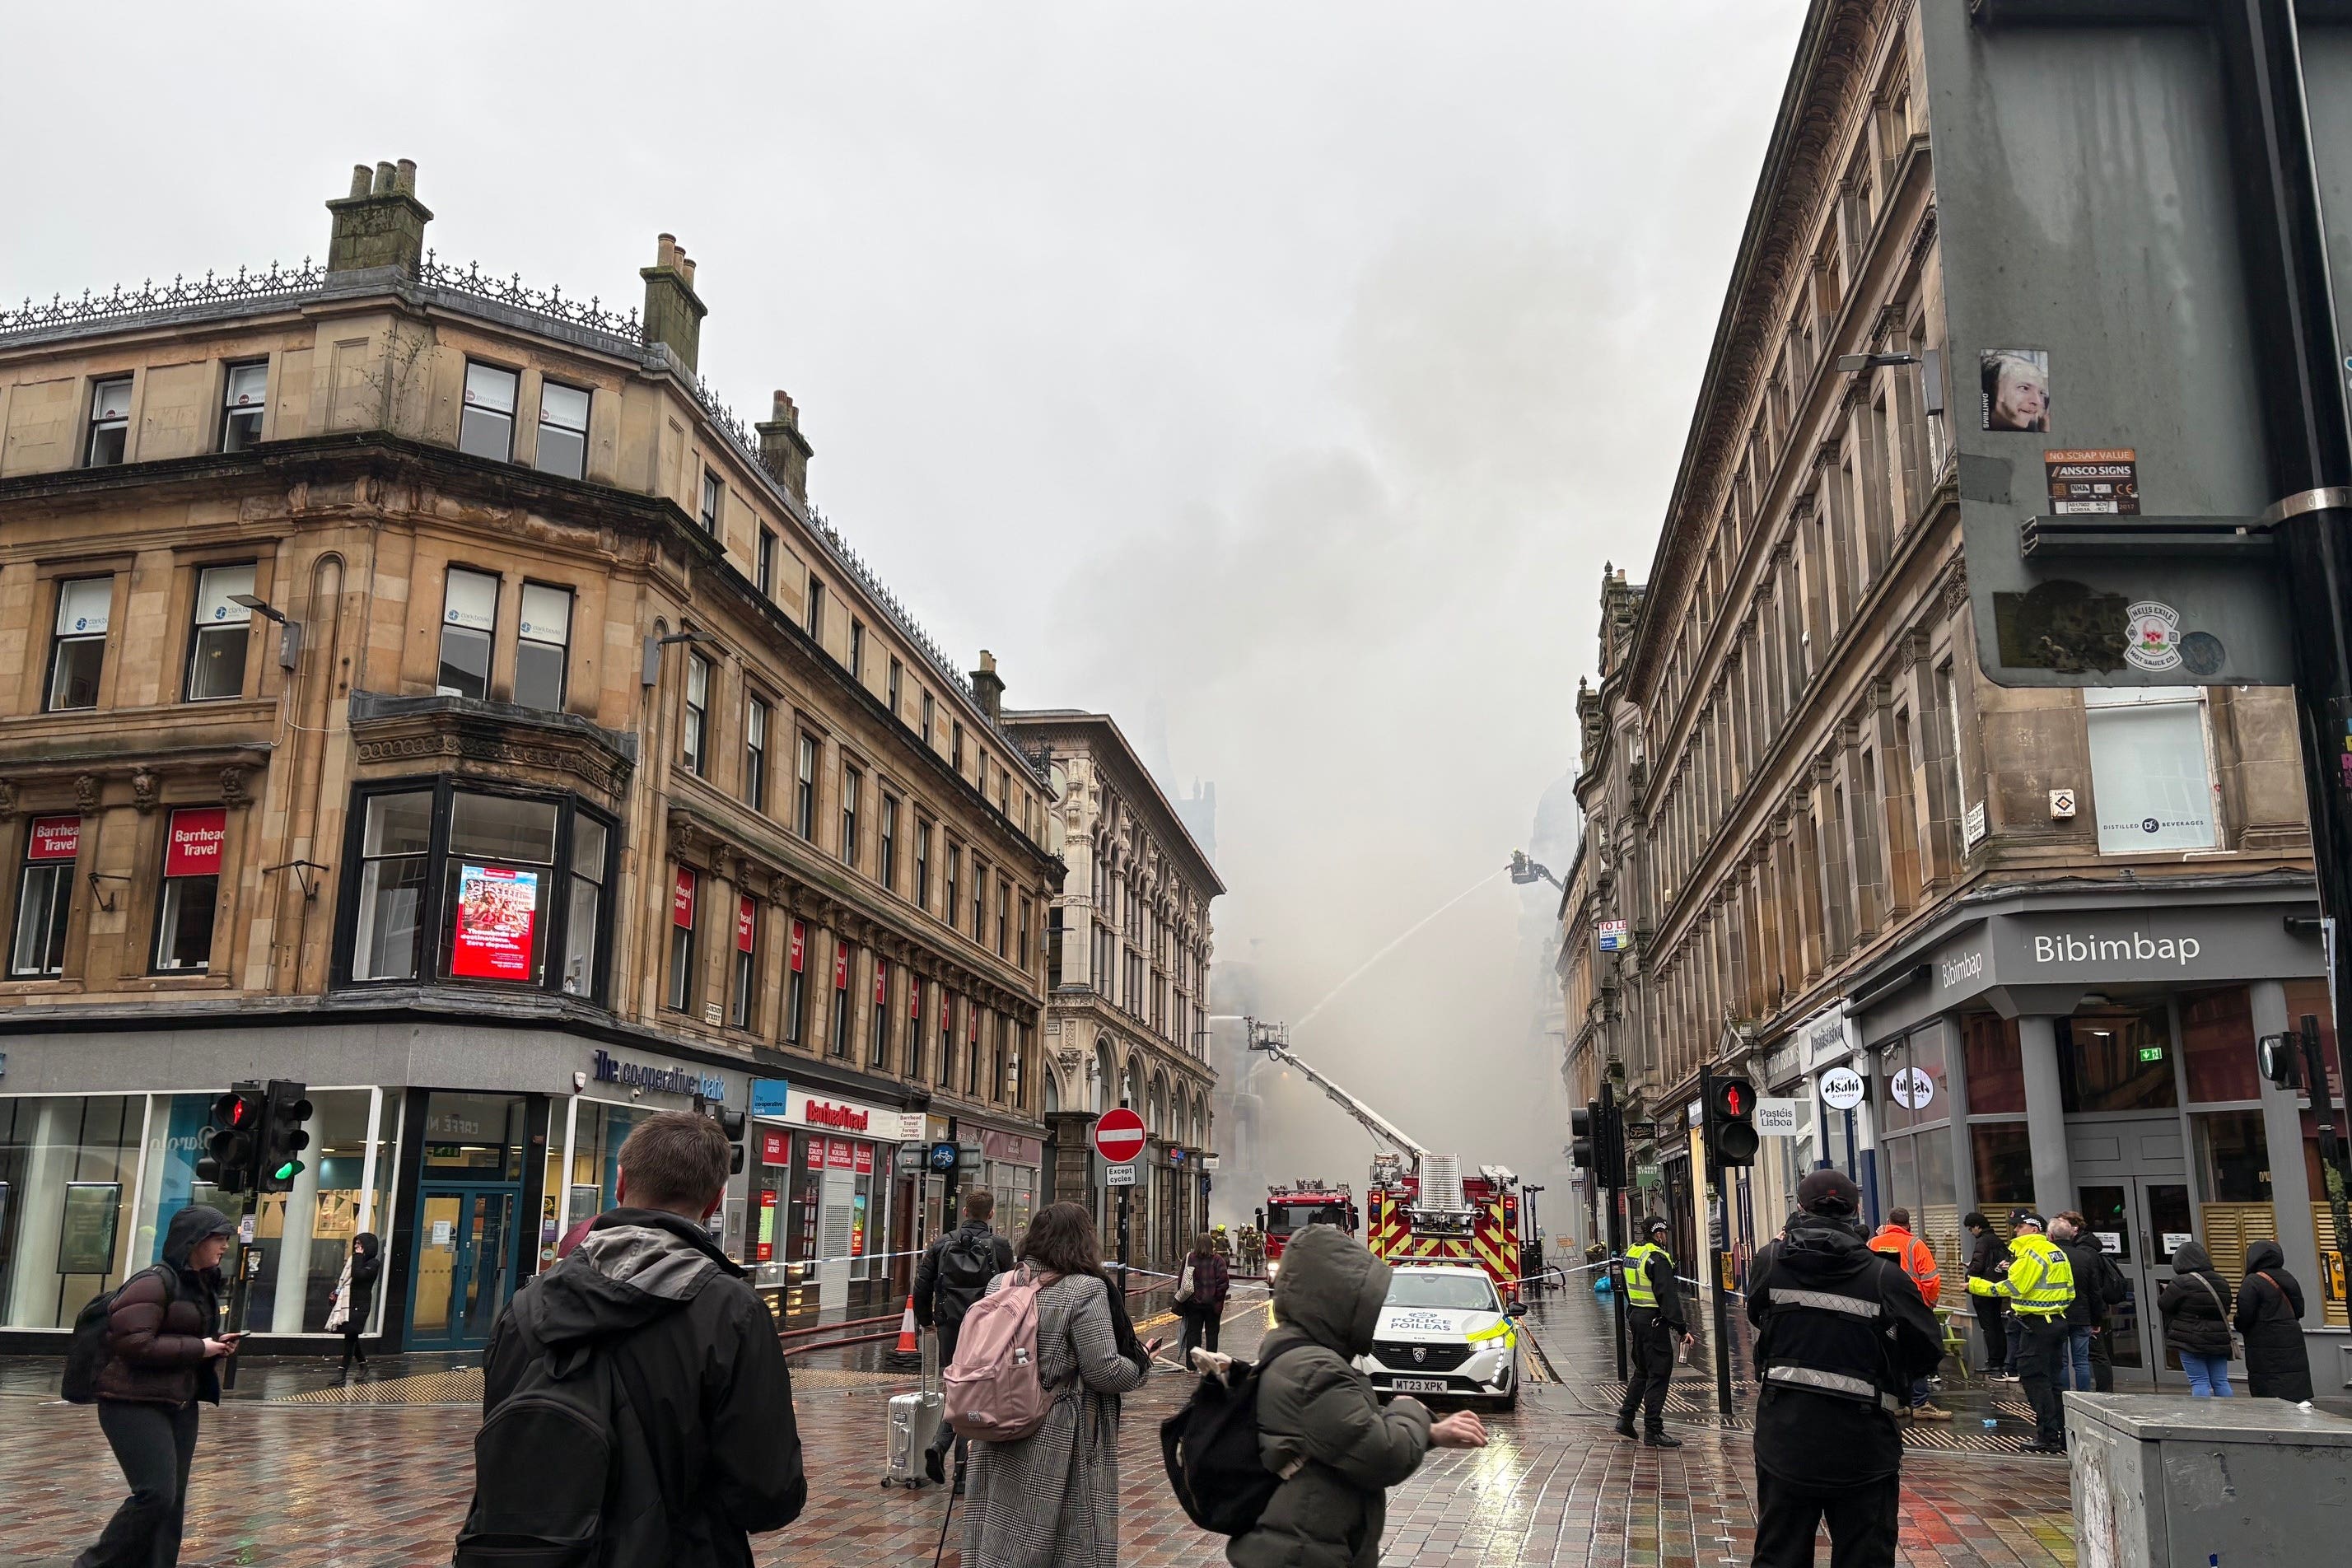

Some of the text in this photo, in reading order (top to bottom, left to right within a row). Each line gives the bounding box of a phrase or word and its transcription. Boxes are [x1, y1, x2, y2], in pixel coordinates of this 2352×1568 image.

[2050, 450, 2130, 460] NO SCRAP VALUE
[2060, 465, 2131, 475] ANSCO SIGNS
[2131, 606, 2174, 620] HELLS EXILE
[2130, 650, 2143, 661] HOT
[2144, 658, 2166, 666] SAUCE
[37, 824, 79, 837] Barrhea
[44, 838, 77, 851] Travel
[184, 842, 217, 856] Travel
[1600, 921, 1627, 931] TO LE
[2034, 932, 2200, 965] Bibimbap
[1942, 952, 1982, 988] Bibimbap
[593, 1049, 619, 1080] The
[702, 1071, 726, 1100] bank
[1825, 1079, 1860, 1094] Asahi
[805, 1099, 869, 1130] Barrhead Travel
[1760, 1108, 1793, 1118] Pastéis
[1761, 1118, 1792, 1127] Lisboa
[1110, 1175, 1132, 1183] cycles
[1391, 1323, 1451, 1331] POILEAS
[1396, 1380, 1443, 1392] MT23 XPK
